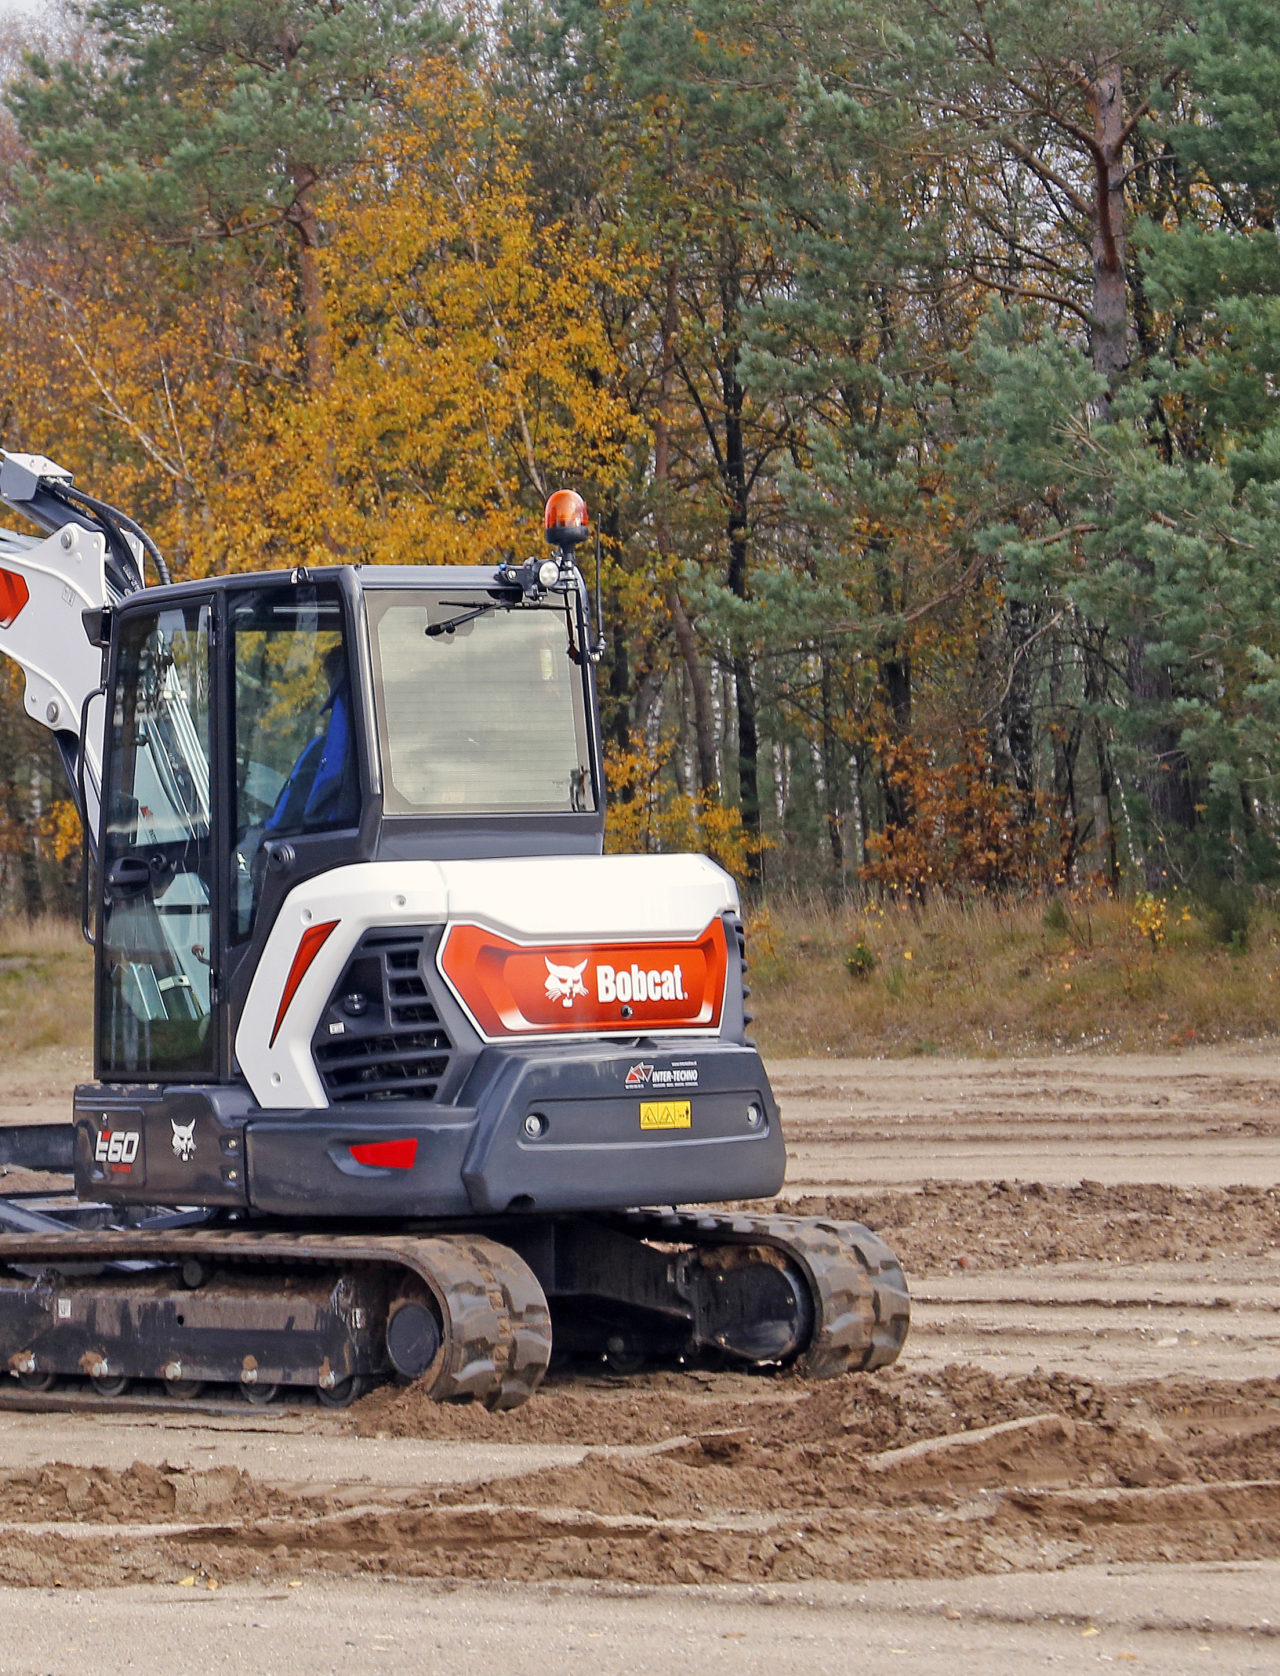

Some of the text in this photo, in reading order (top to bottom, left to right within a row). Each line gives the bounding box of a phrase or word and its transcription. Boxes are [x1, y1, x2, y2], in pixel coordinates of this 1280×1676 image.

[596, 964, 684, 1003] Bobcat
[652, 1069, 698, 1083] INTER-TECHNO
[95, 1131, 140, 1163] E60
